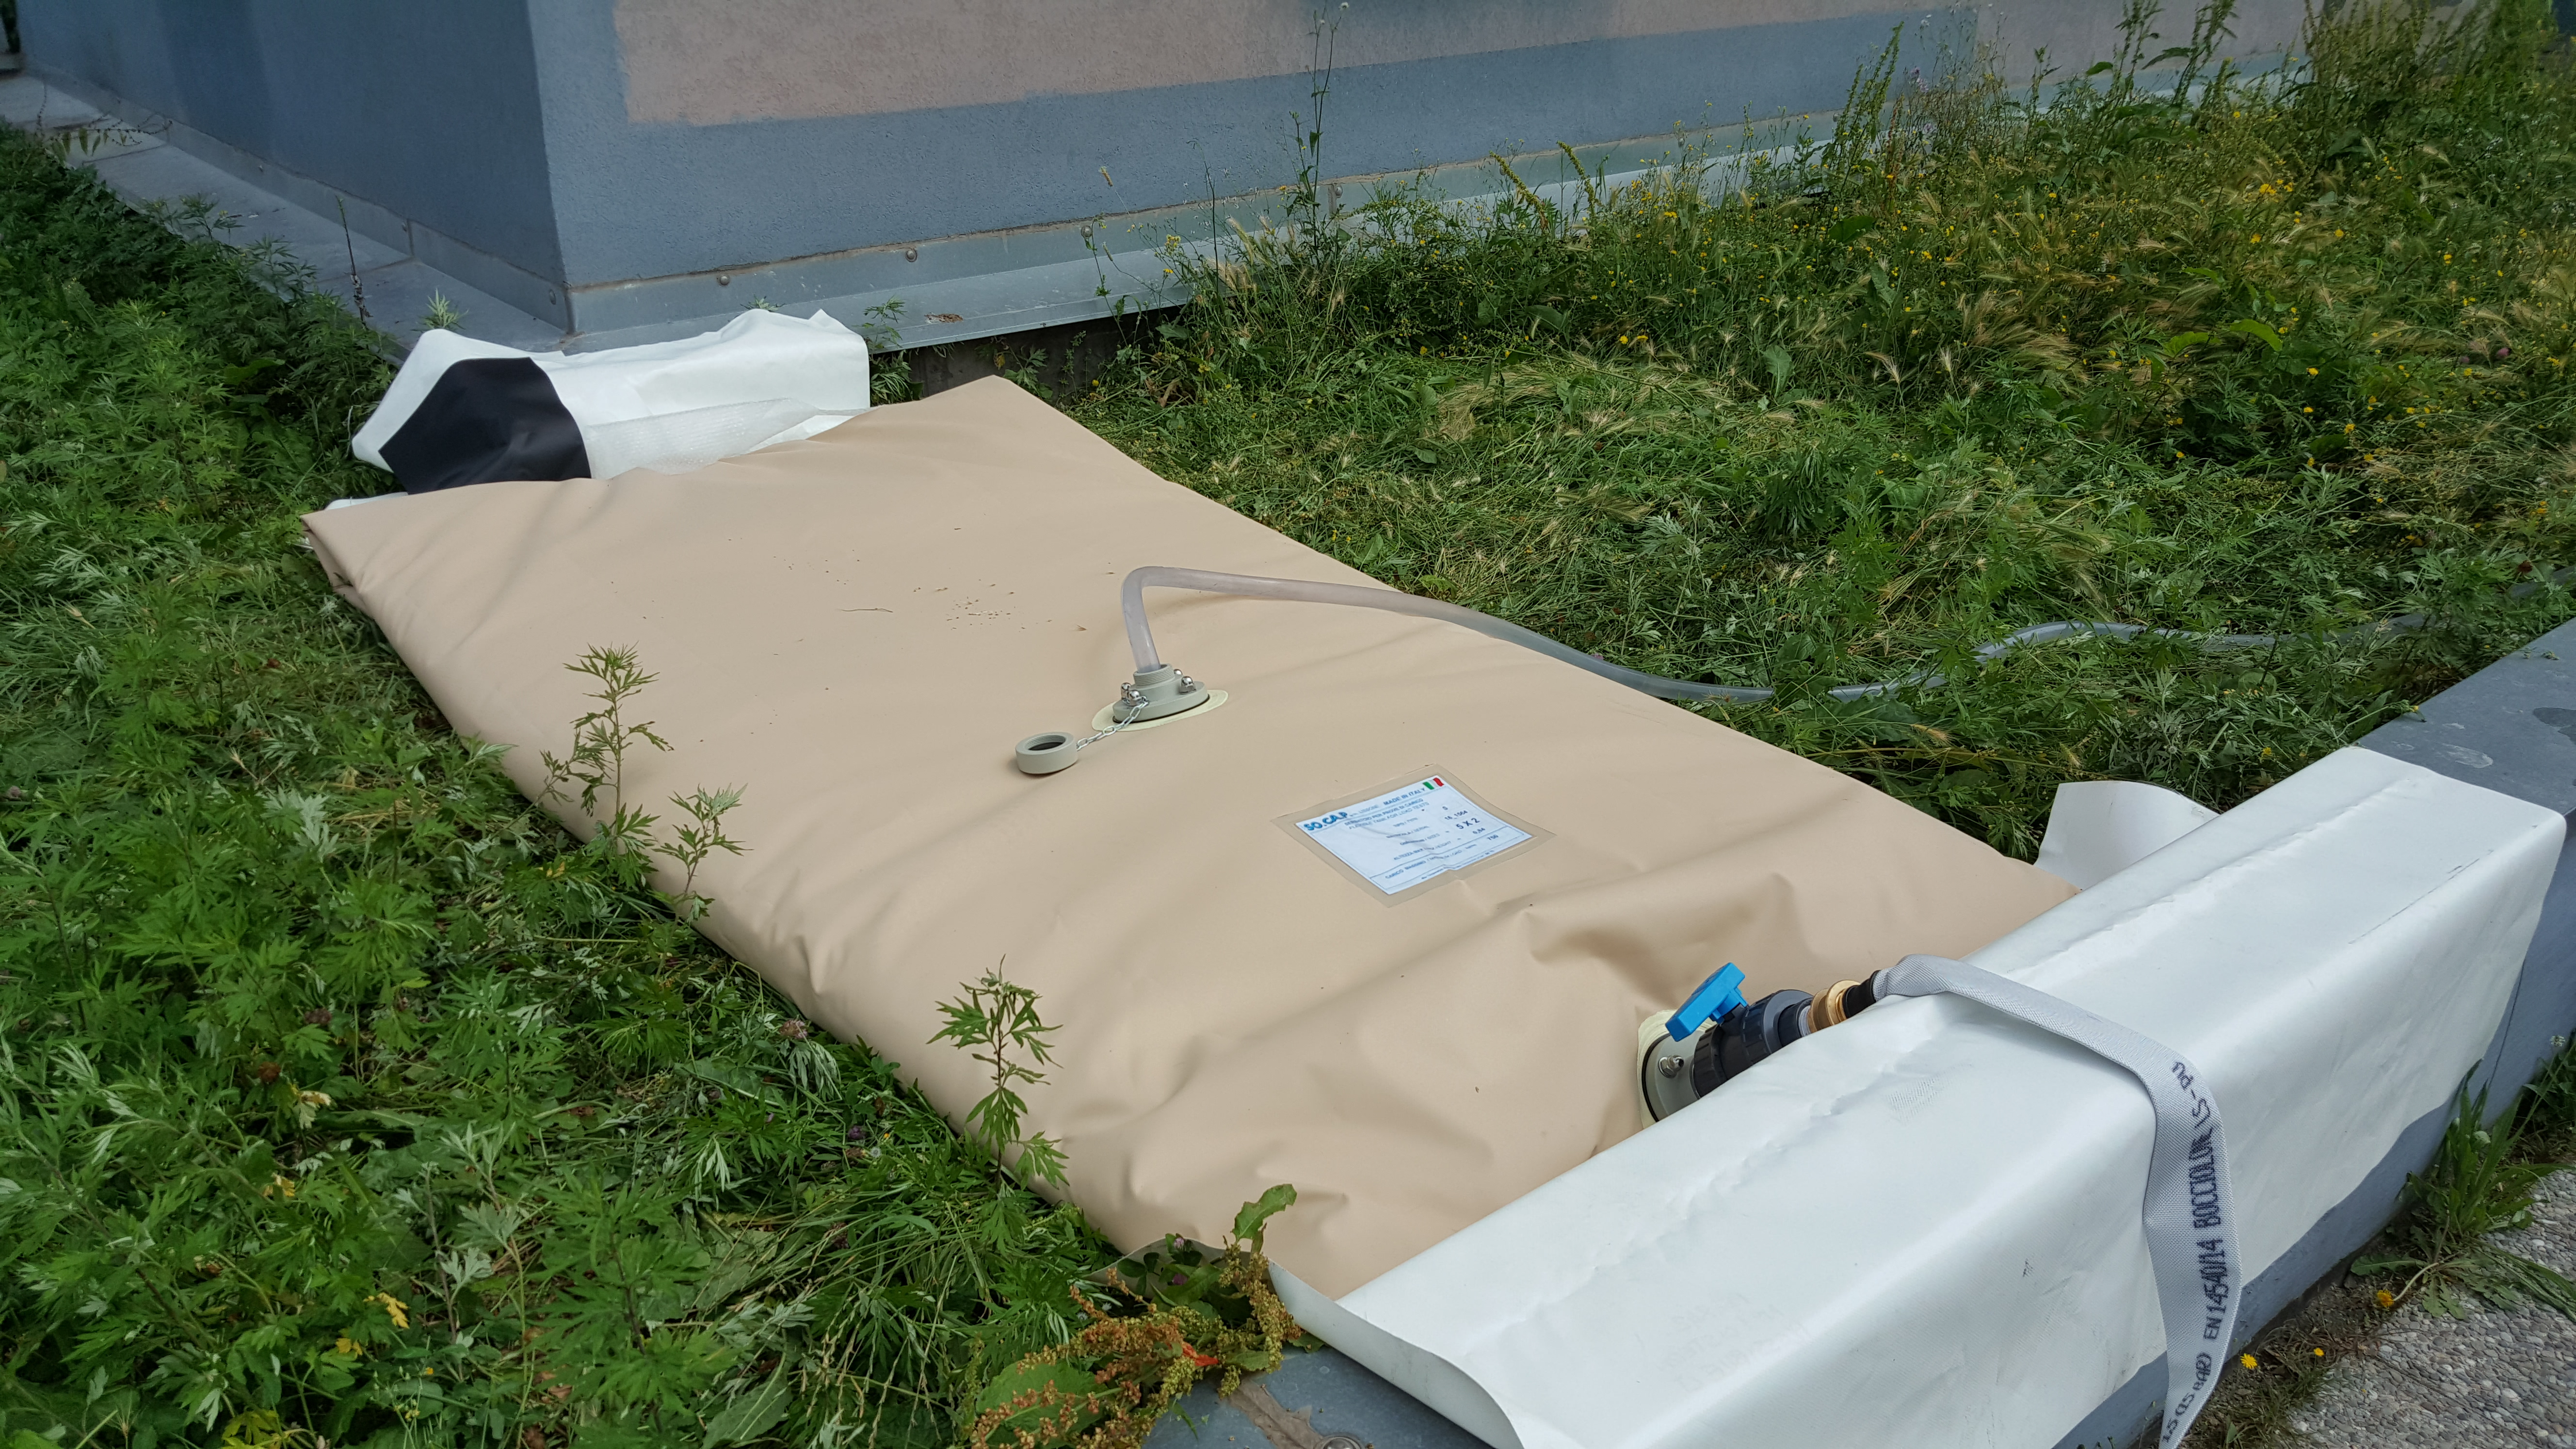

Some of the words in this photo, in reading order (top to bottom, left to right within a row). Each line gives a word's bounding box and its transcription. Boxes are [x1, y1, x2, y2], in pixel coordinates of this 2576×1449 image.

[1383, 796, 1401, 805] MADE
[1409, 788, 1426, 796] ITALY
[2203, 1316, 2223, 1339] EN
